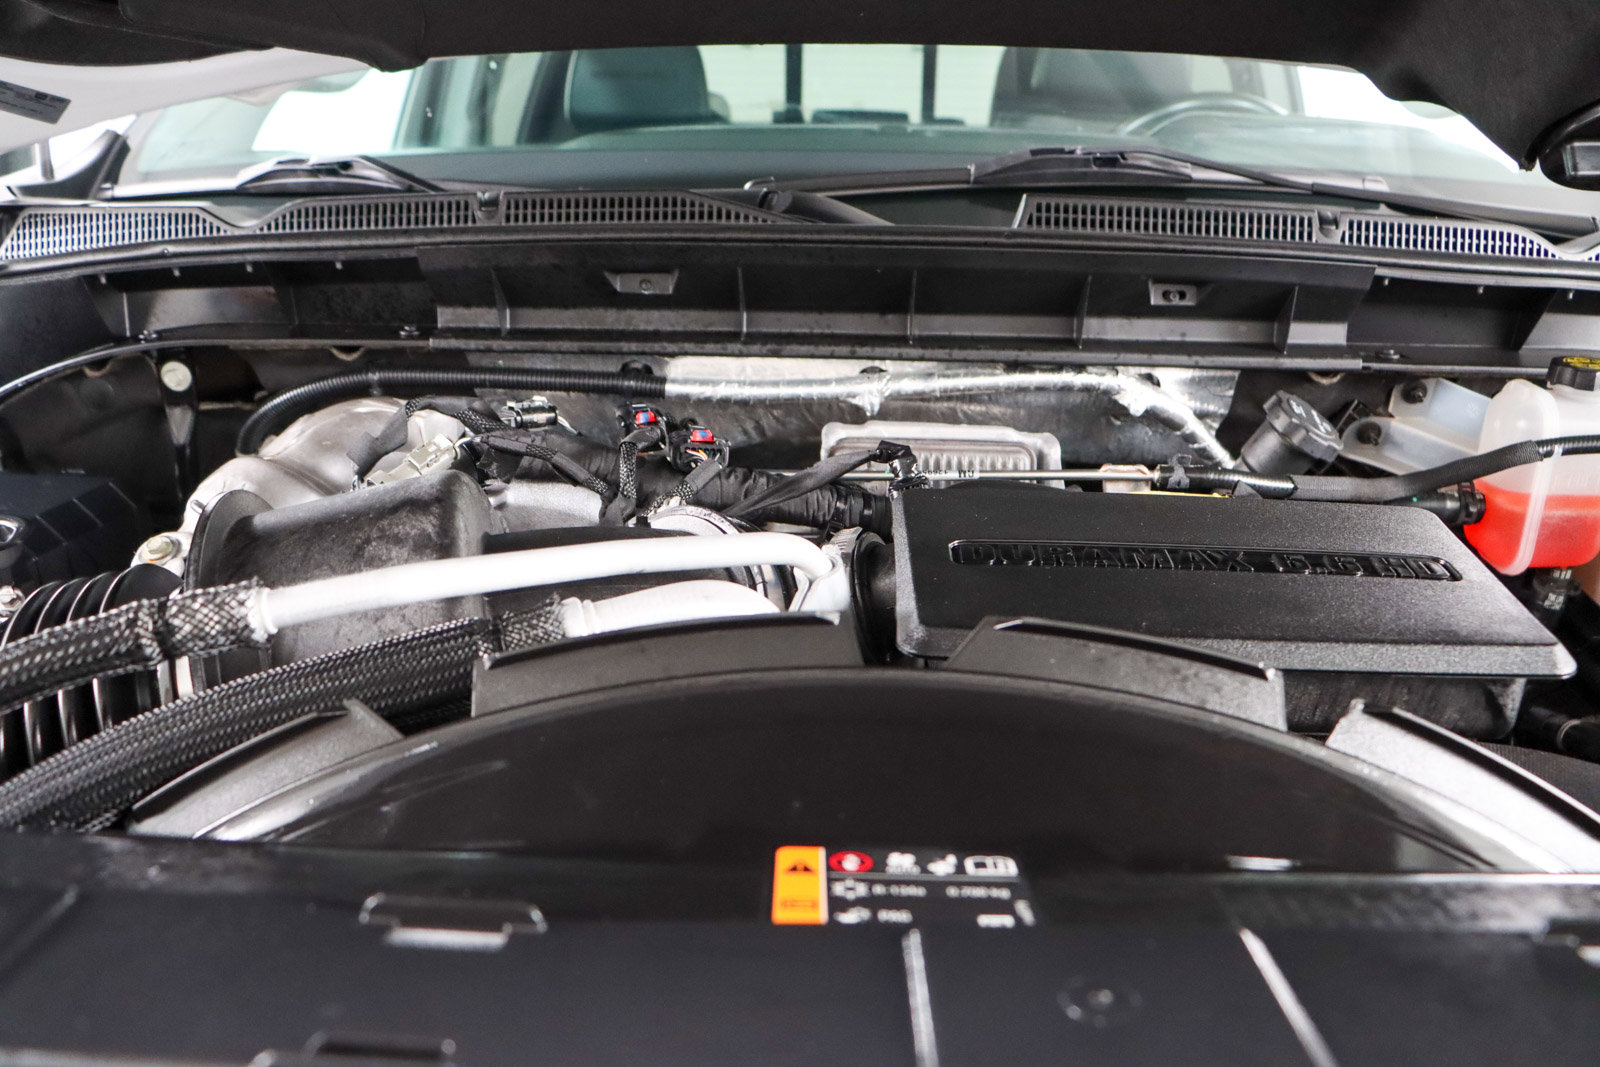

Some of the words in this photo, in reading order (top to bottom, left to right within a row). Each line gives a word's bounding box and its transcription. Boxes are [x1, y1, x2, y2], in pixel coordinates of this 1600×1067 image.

[957, 543, 1254, 571] DURAMAX
[1270, 552, 1364, 575] 6.6
[1369, 555, 1451, 580] HD
